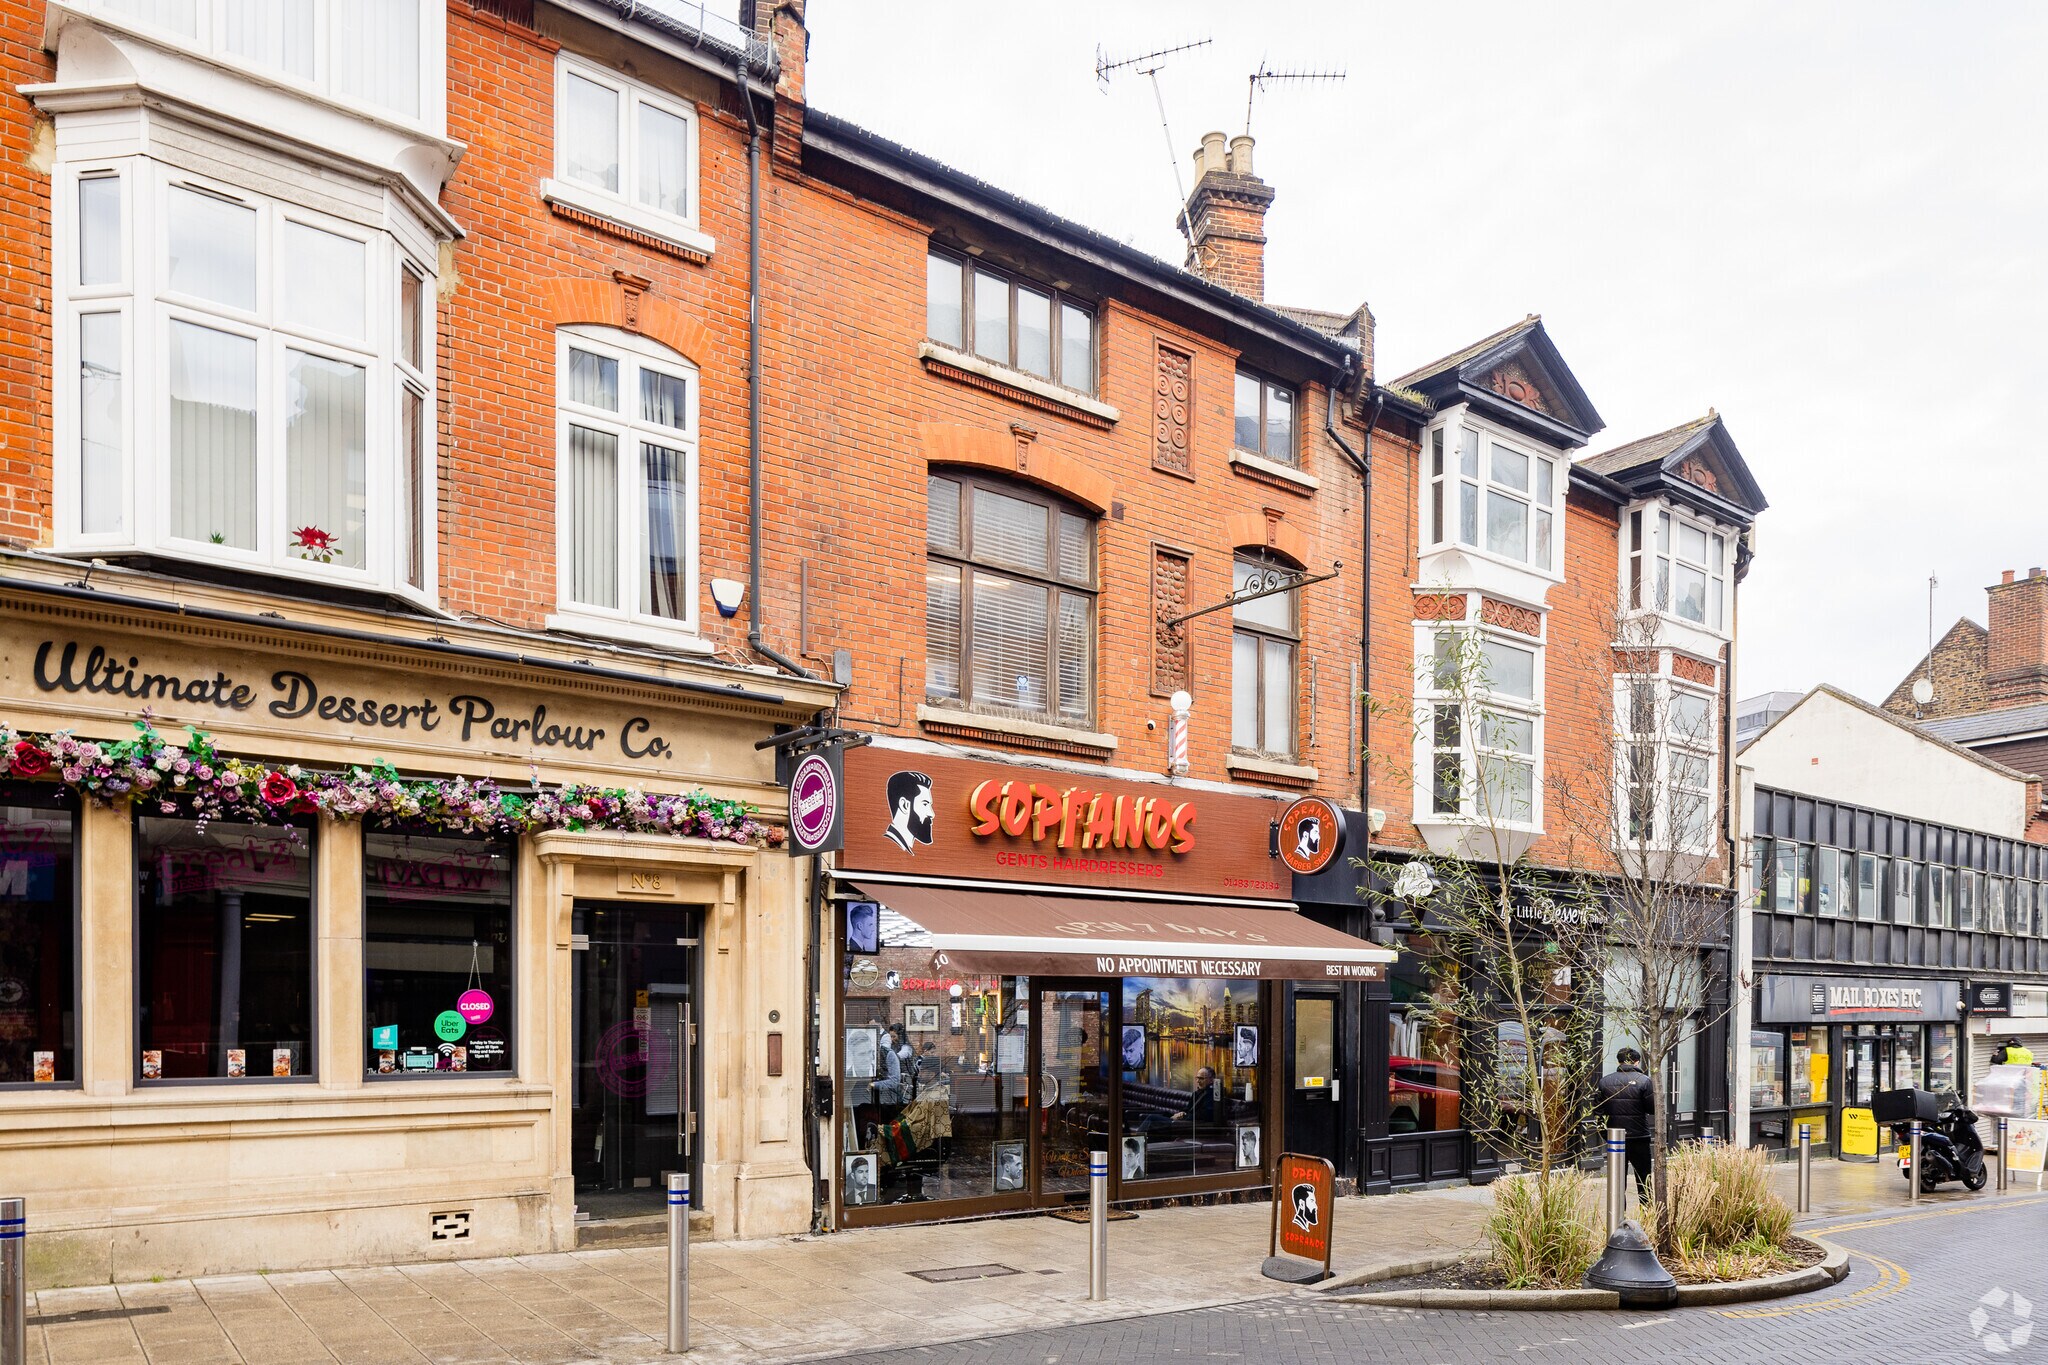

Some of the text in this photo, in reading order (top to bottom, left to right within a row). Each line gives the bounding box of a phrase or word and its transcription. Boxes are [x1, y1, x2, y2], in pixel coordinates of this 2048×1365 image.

[34, 641, 673, 760] Ultimate Dessert Parlour Co.
[970, 779, 1198, 854] SOPRANOS
[1284, 805, 1333, 831] SOPRANOS
[161, 840, 291, 879] treatz
[996, 852, 1164, 878] GENTS HAIRDRESSERS
[1285, 848, 1330, 870] BARBER SHOP
[1223, 878, 1249, 889] 01483
[1516, 905, 1542, 919] Little
[1055, 921, 1268, 942] OPEN 7 DAYS
[934, 953, 949, 970] 10
[1096, 957, 1262, 976] NO APPOINTMENT NECESSARY
[1326, 964, 1377, 977] BEST IN WOKING
[460, 1002, 491, 1011] CLOSED
[1830, 986, 1862, 1007] MAIL
[1864, 987, 1900, 1008] BOXES
[1900, 988, 1923, 1008] ETC.
[1291, 1167, 1322, 1181] OPEN
[1285, 1232, 1325, 1250] SOPRANOS
